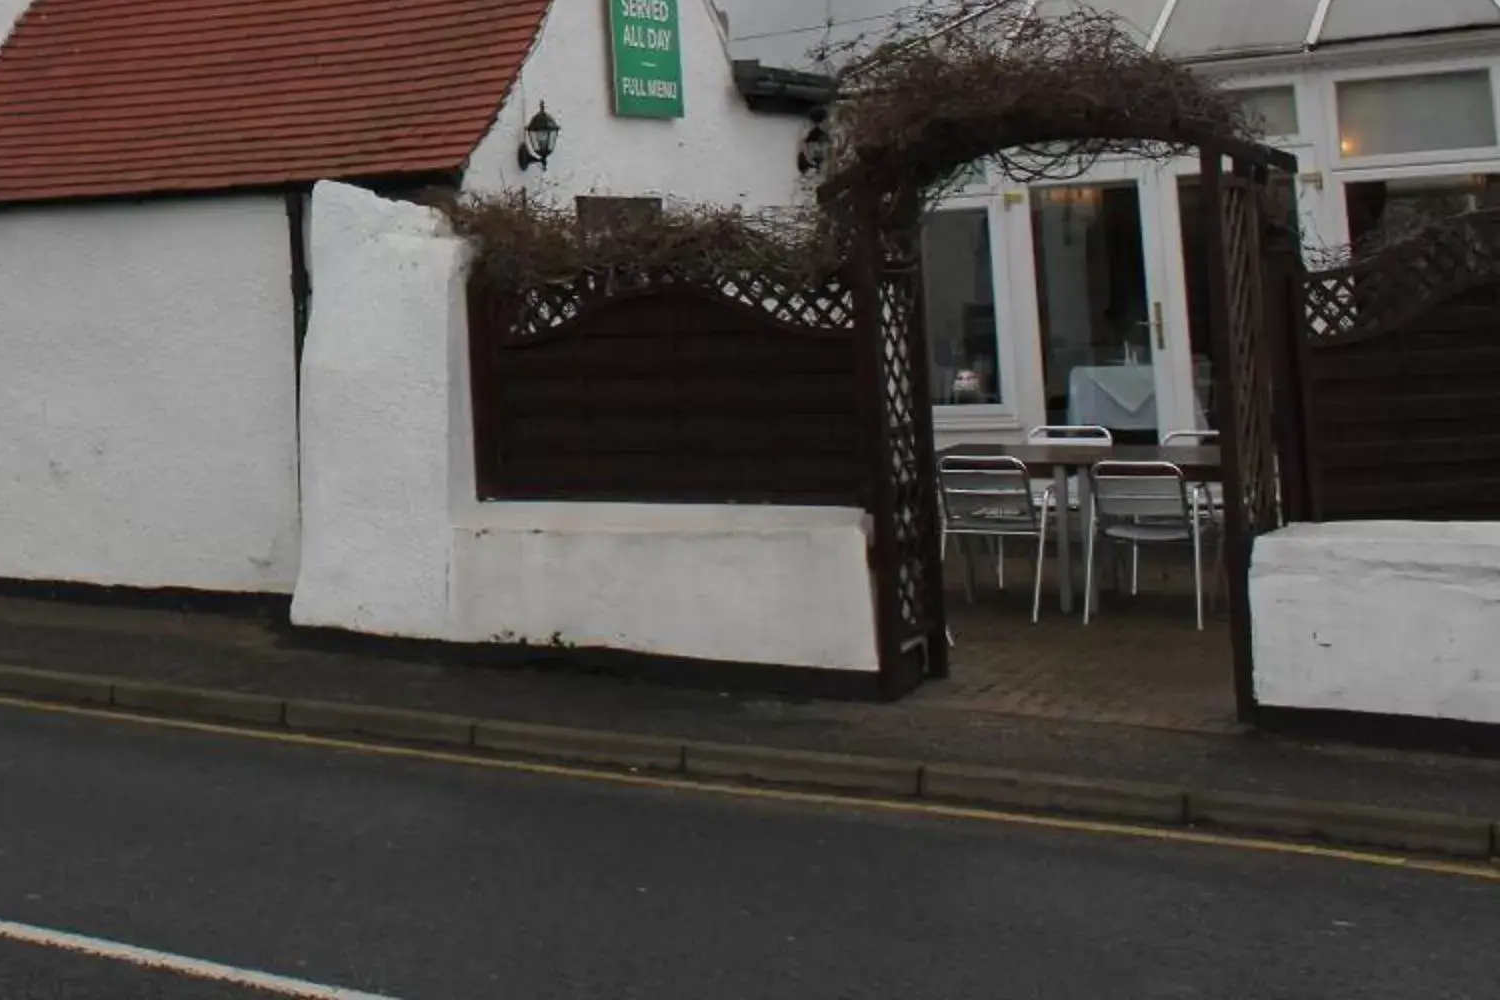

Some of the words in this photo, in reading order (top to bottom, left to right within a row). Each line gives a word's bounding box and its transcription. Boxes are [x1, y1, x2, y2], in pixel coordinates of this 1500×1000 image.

[623, 24, 645, 48] ALL
[647, 28, 671, 51] DAY
[622, 77, 647, 98] FULL
[648, 79, 677, 100] MENU
